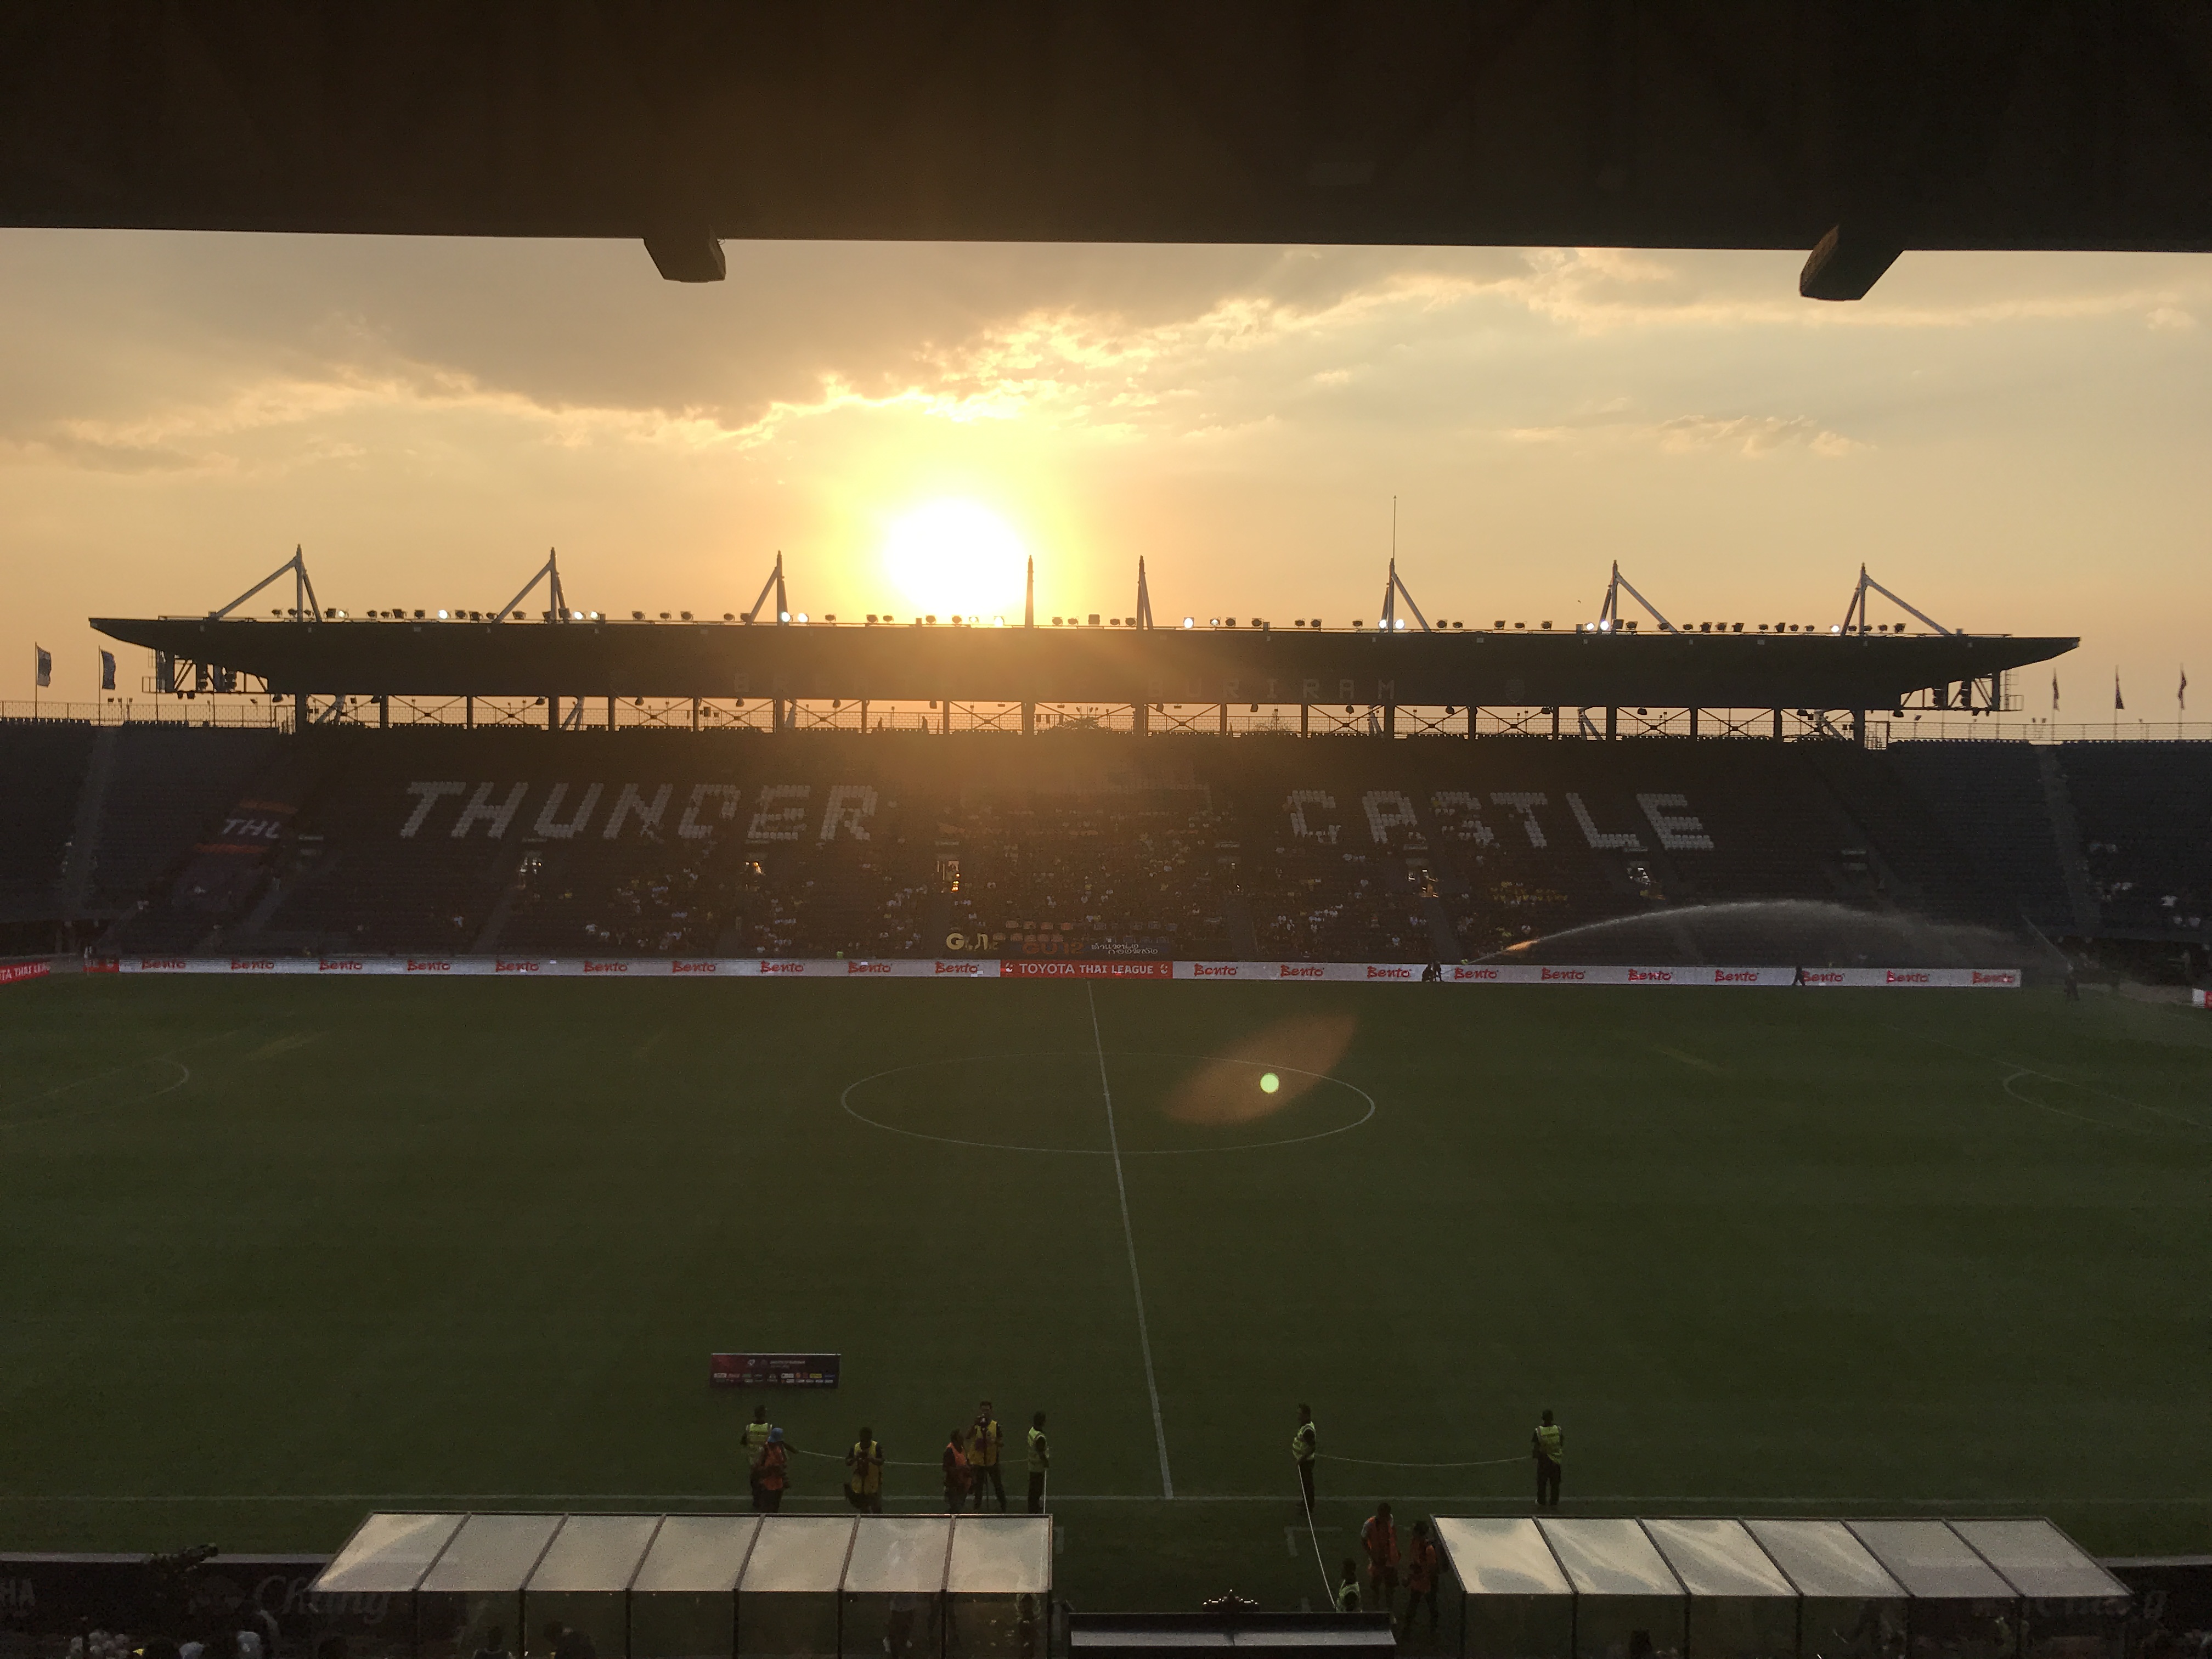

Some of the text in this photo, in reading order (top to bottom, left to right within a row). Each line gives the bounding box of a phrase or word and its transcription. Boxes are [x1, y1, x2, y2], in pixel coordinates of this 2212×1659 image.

[1147, 678, 1395, 699] BURIRAM
[400, 781, 1714, 850] THUNDER CASTLE
[319, 959, 362, 971] Bento
[407, 960, 450, 972] Bento
[495, 960, 539, 972] Bento
[583, 961, 628, 973] Bento
[672, 961, 715, 973] Bento
[760, 961, 804, 973] Bento
[848, 961, 891, 973] Bento
[935, 961, 978, 974] Bento
[1019, 963, 1154, 974] TOYOTA THAI LEAGUE
[1193, 963, 1237, 977] Bento
[1280, 964, 1324, 977] Bento
[1367, 966, 1410, 979] Bento
[1454, 967, 1497, 980] Bento
[1541, 968, 1585, 980] Bento
[1628, 969, 1672, 981] Bento
[1714, 969, 1757, 982] Bento
[1886, 970, 1928, 983] Bento
